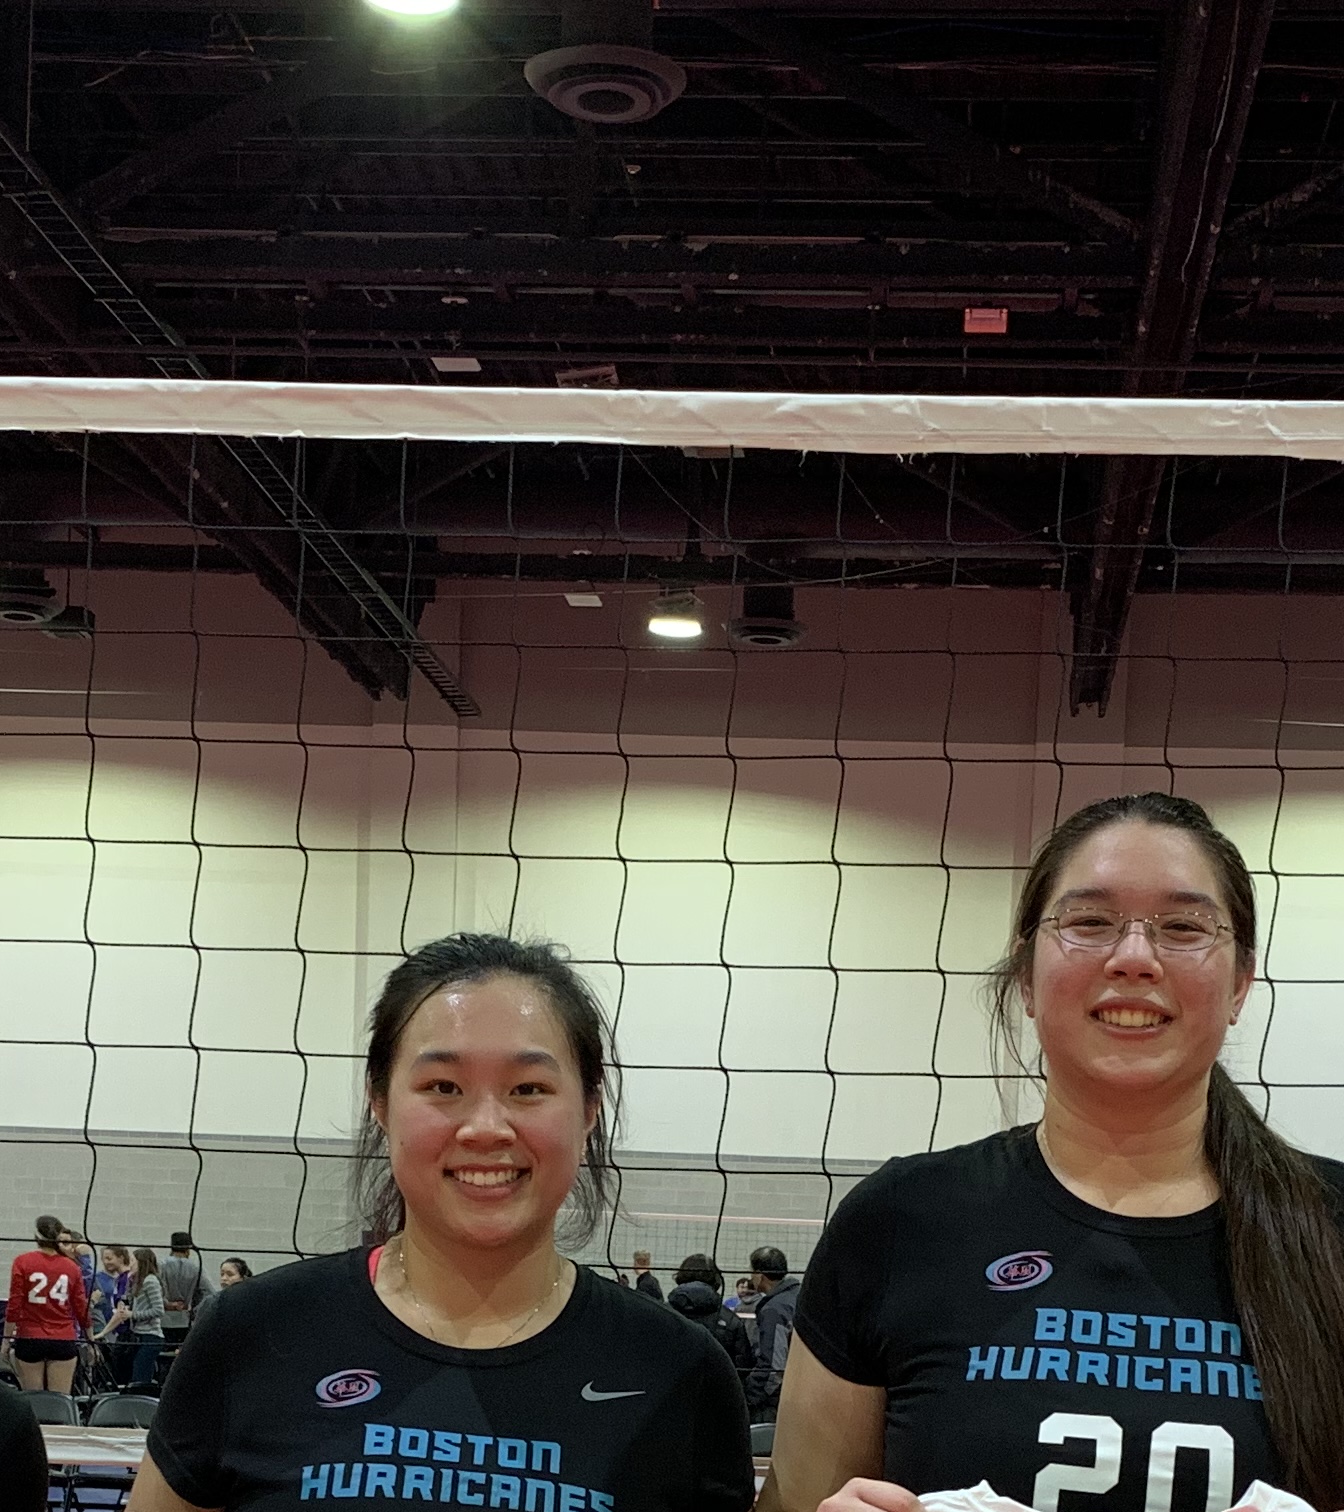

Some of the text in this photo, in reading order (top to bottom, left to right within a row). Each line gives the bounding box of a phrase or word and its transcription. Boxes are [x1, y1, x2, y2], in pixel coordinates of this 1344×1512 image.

[28, 1272, 69, 1306] 24
[1035, 1308, 1242, 1356] BOSTON
[966, 1346, 1264, 1401] HURRICANE
[363, 1423, 561, 1474] BOSTON
